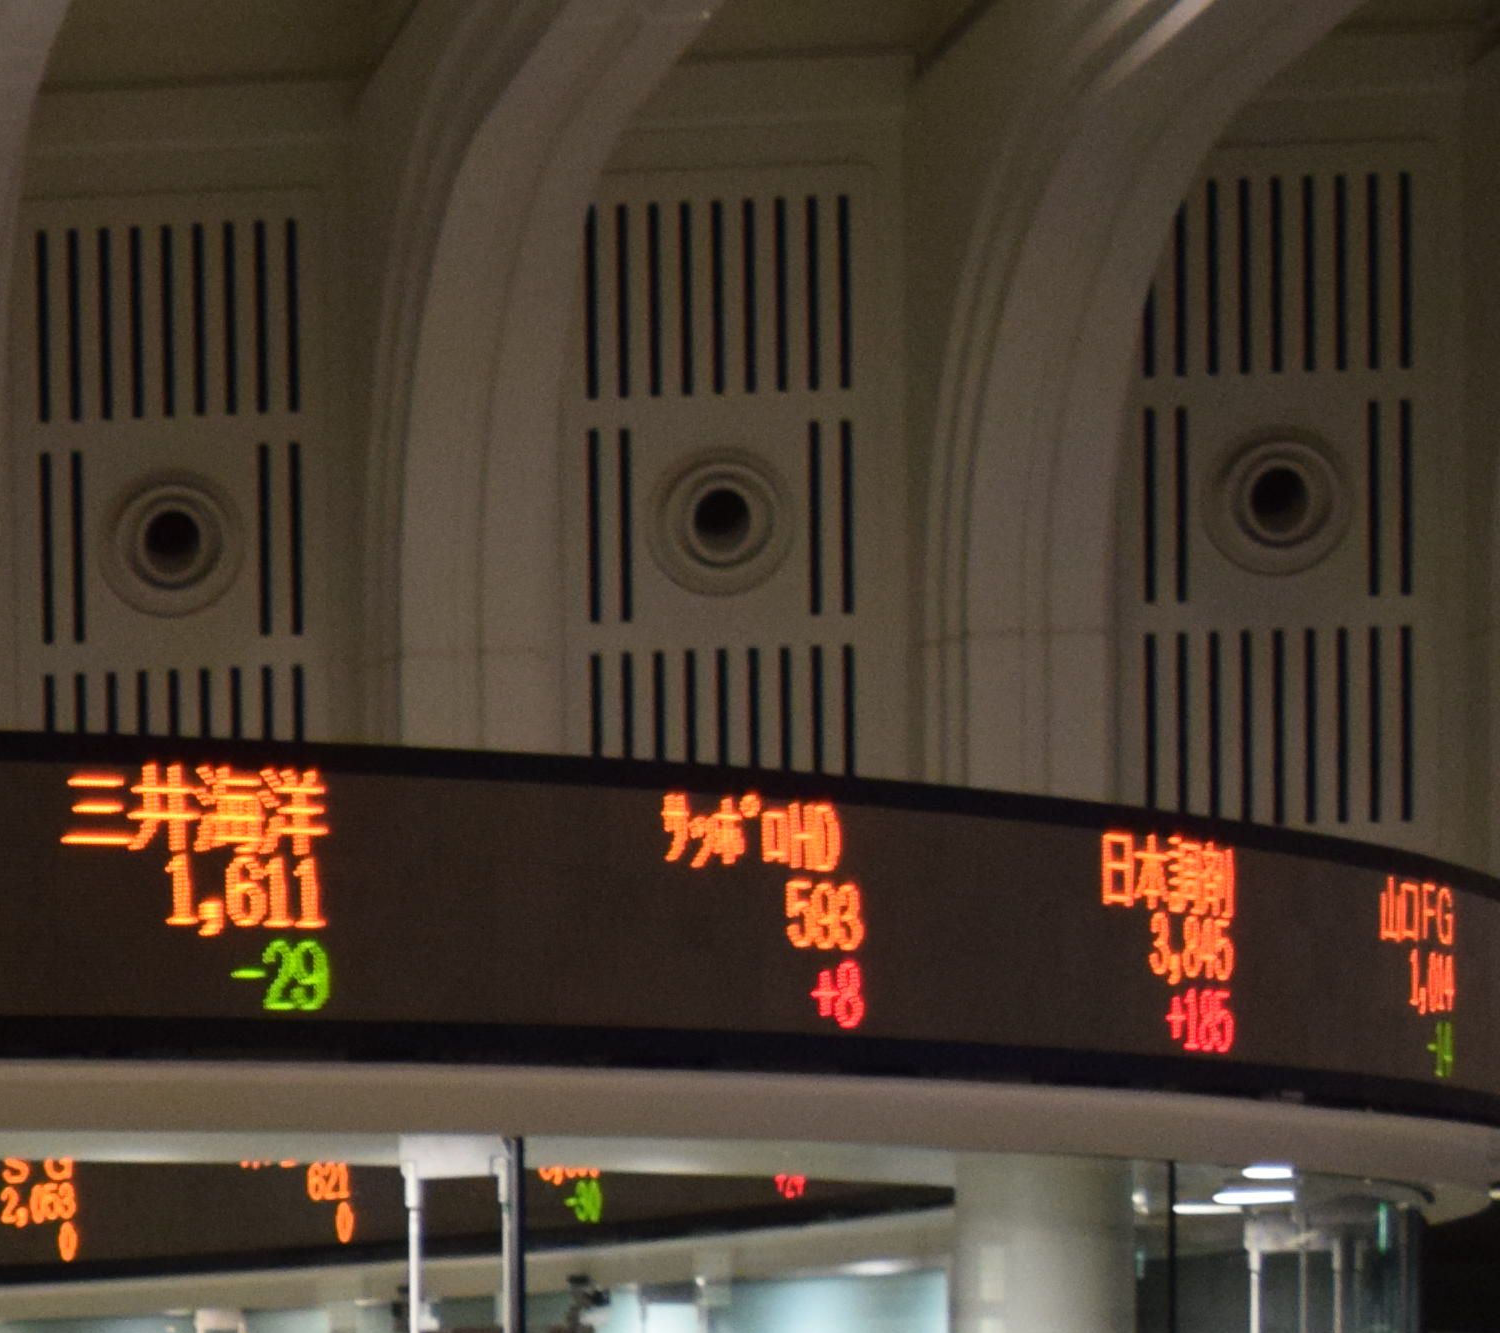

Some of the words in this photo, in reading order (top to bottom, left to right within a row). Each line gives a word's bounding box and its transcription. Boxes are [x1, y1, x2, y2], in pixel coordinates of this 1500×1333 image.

[60, 765, 328, 854] 三井海洋
[166, 854, 326, 936] 1,611
[1102, 833, 1235, 918] 日本調剤
[786, 881, 864, 949] 593
[1380, 877, 1453, 944] 山口FG
[231, 940, 329, 1010] -29
[1150, 911, 1235, 984] 3,845
[811, 960, 864, 1028] +8
[1166, 988, 1235, 1053] +185
[0, 1182, 77, 1228] 2,053
[307, 1161, 350, 1201] 621
[58, 1221, 79, 1262] 0
[335, 1201, 354, 1244] 0
